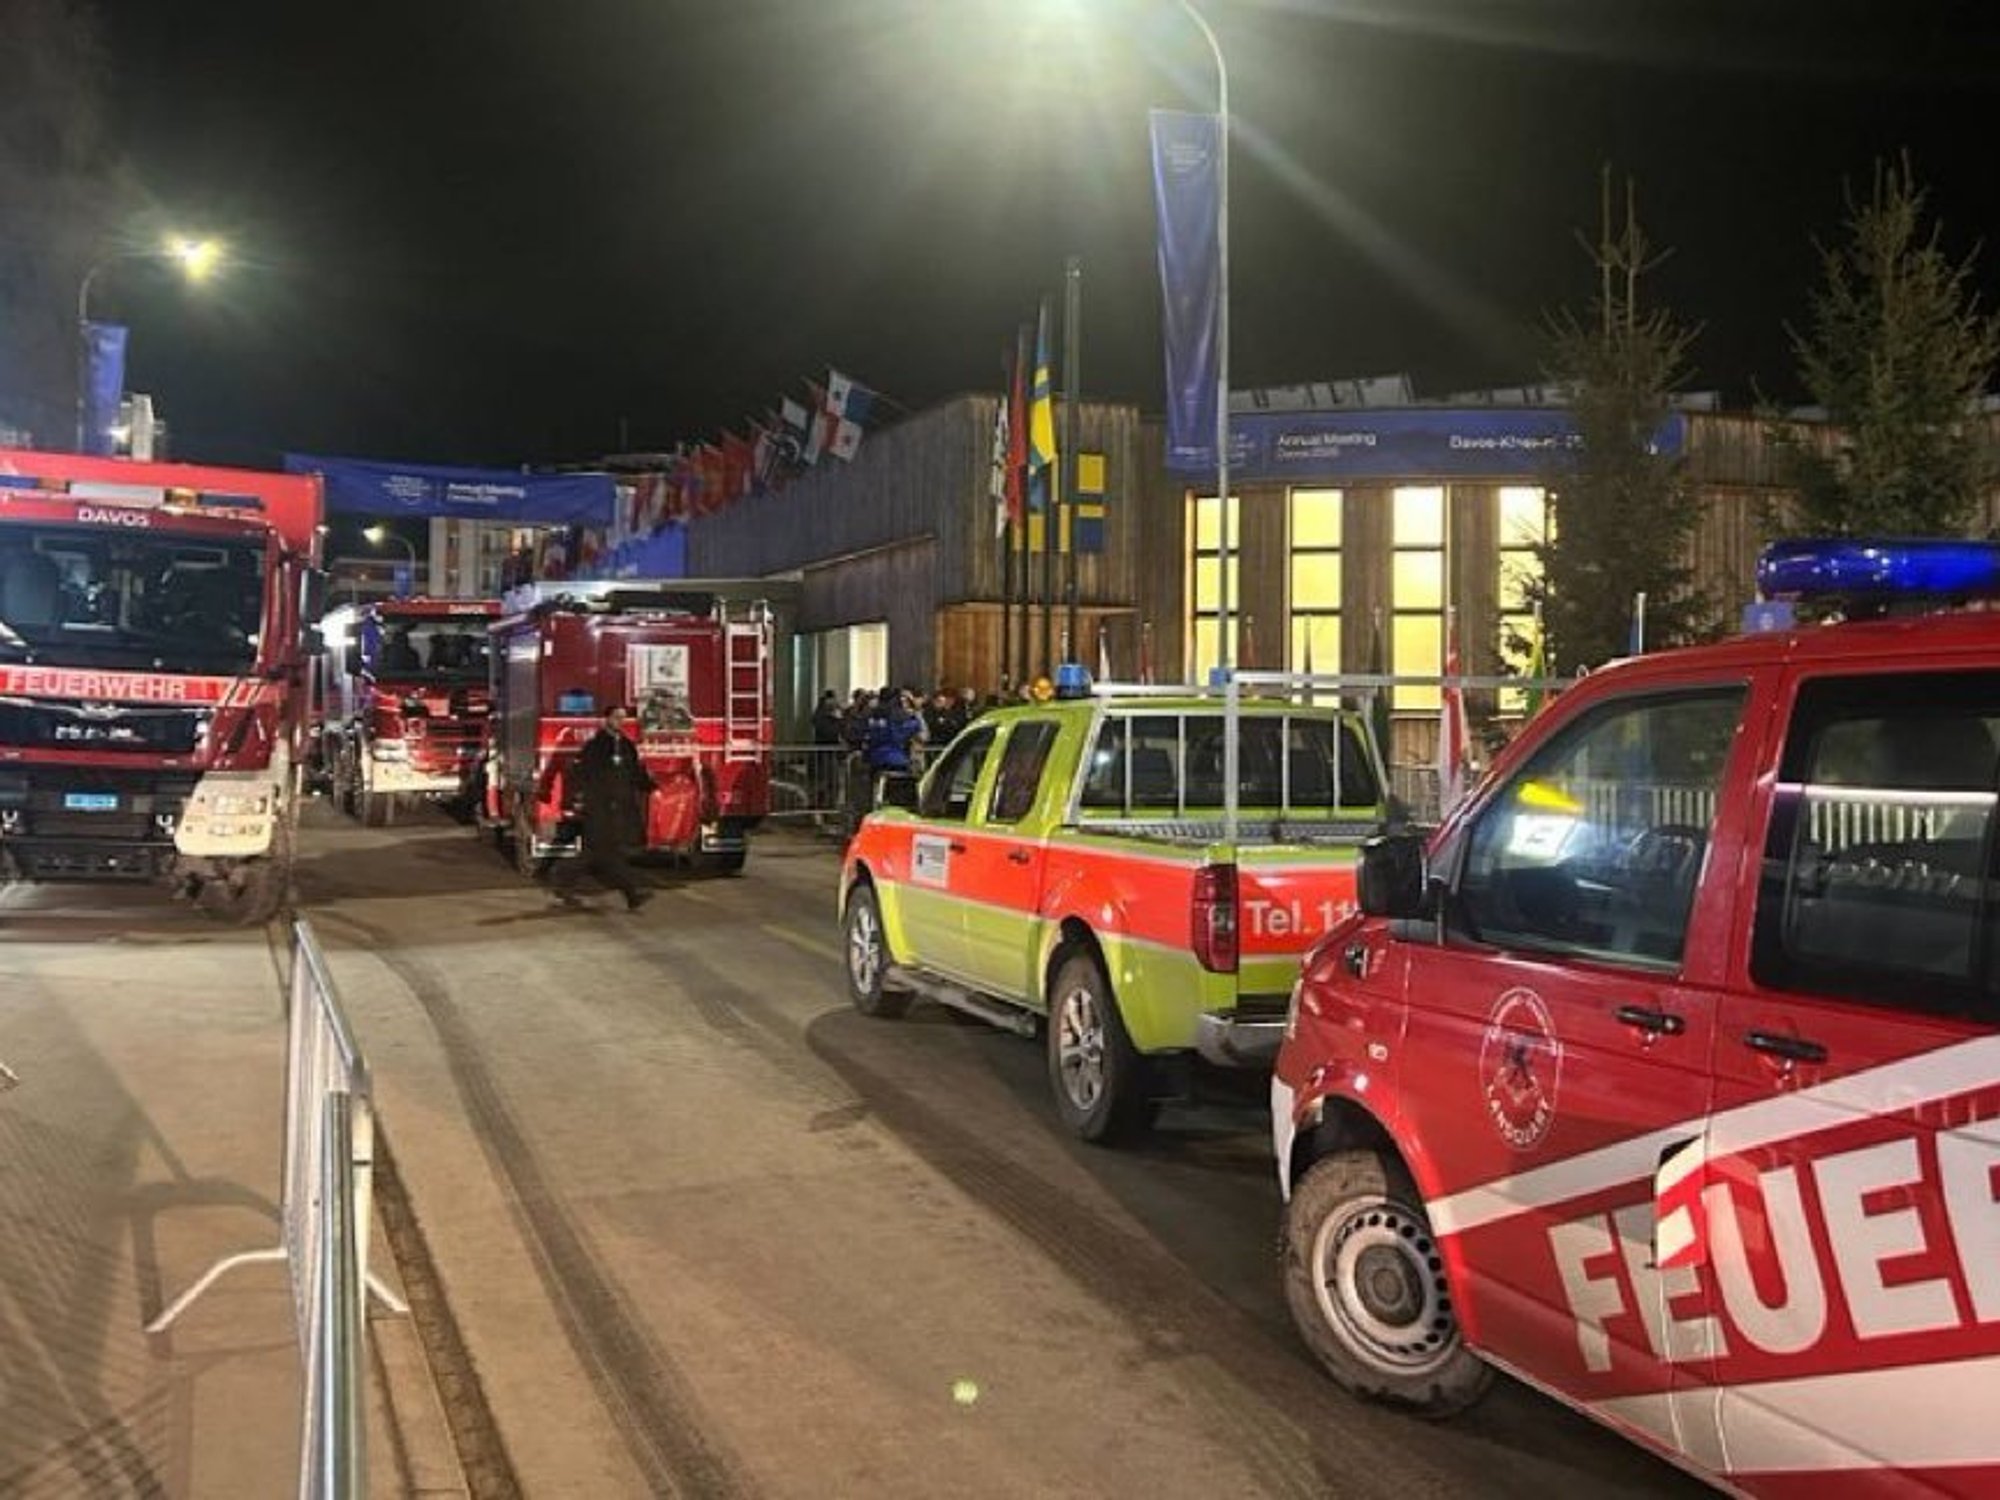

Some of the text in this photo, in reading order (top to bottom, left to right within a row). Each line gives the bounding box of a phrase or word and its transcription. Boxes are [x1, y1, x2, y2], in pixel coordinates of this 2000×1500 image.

[77, 507, 150, 527] DAVOS
[6, 672, 187, 700] FEUERWEHR
[1244, 900, 1313, 936] Tel.
